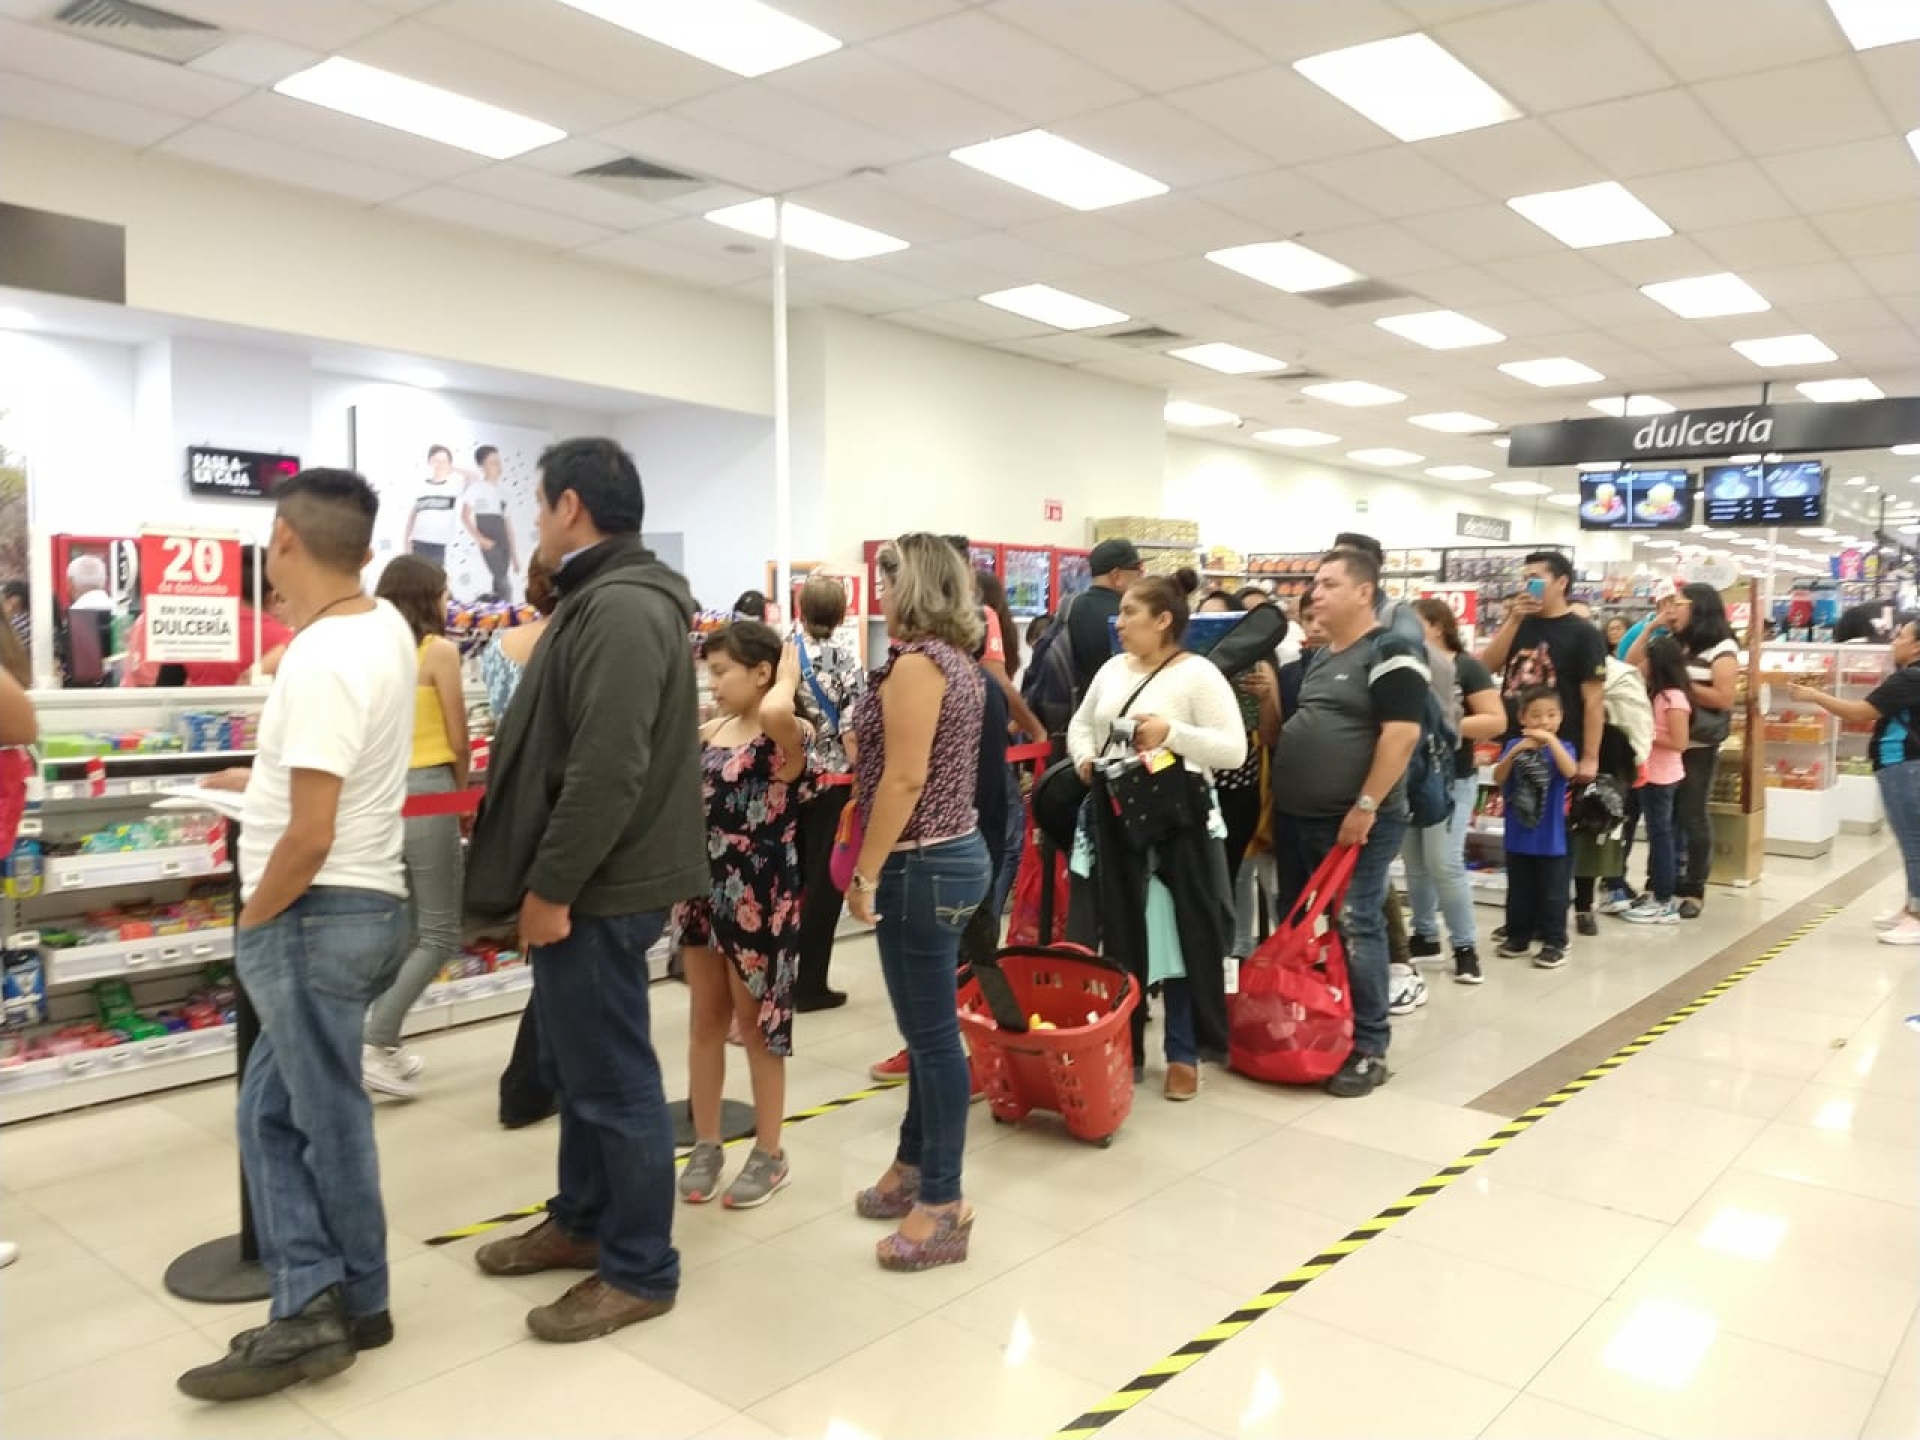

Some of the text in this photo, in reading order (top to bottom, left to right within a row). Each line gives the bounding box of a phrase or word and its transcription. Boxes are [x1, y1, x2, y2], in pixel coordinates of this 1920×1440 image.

[1632, 411, 1774, 450] dulcería
[194, 467, 251, 487] LA CAJA
[161, 538, 224, 584] 20
[160, 605, 225, 617] EN TODA LA
[152, 617, 231, 636] DULCERÍA
